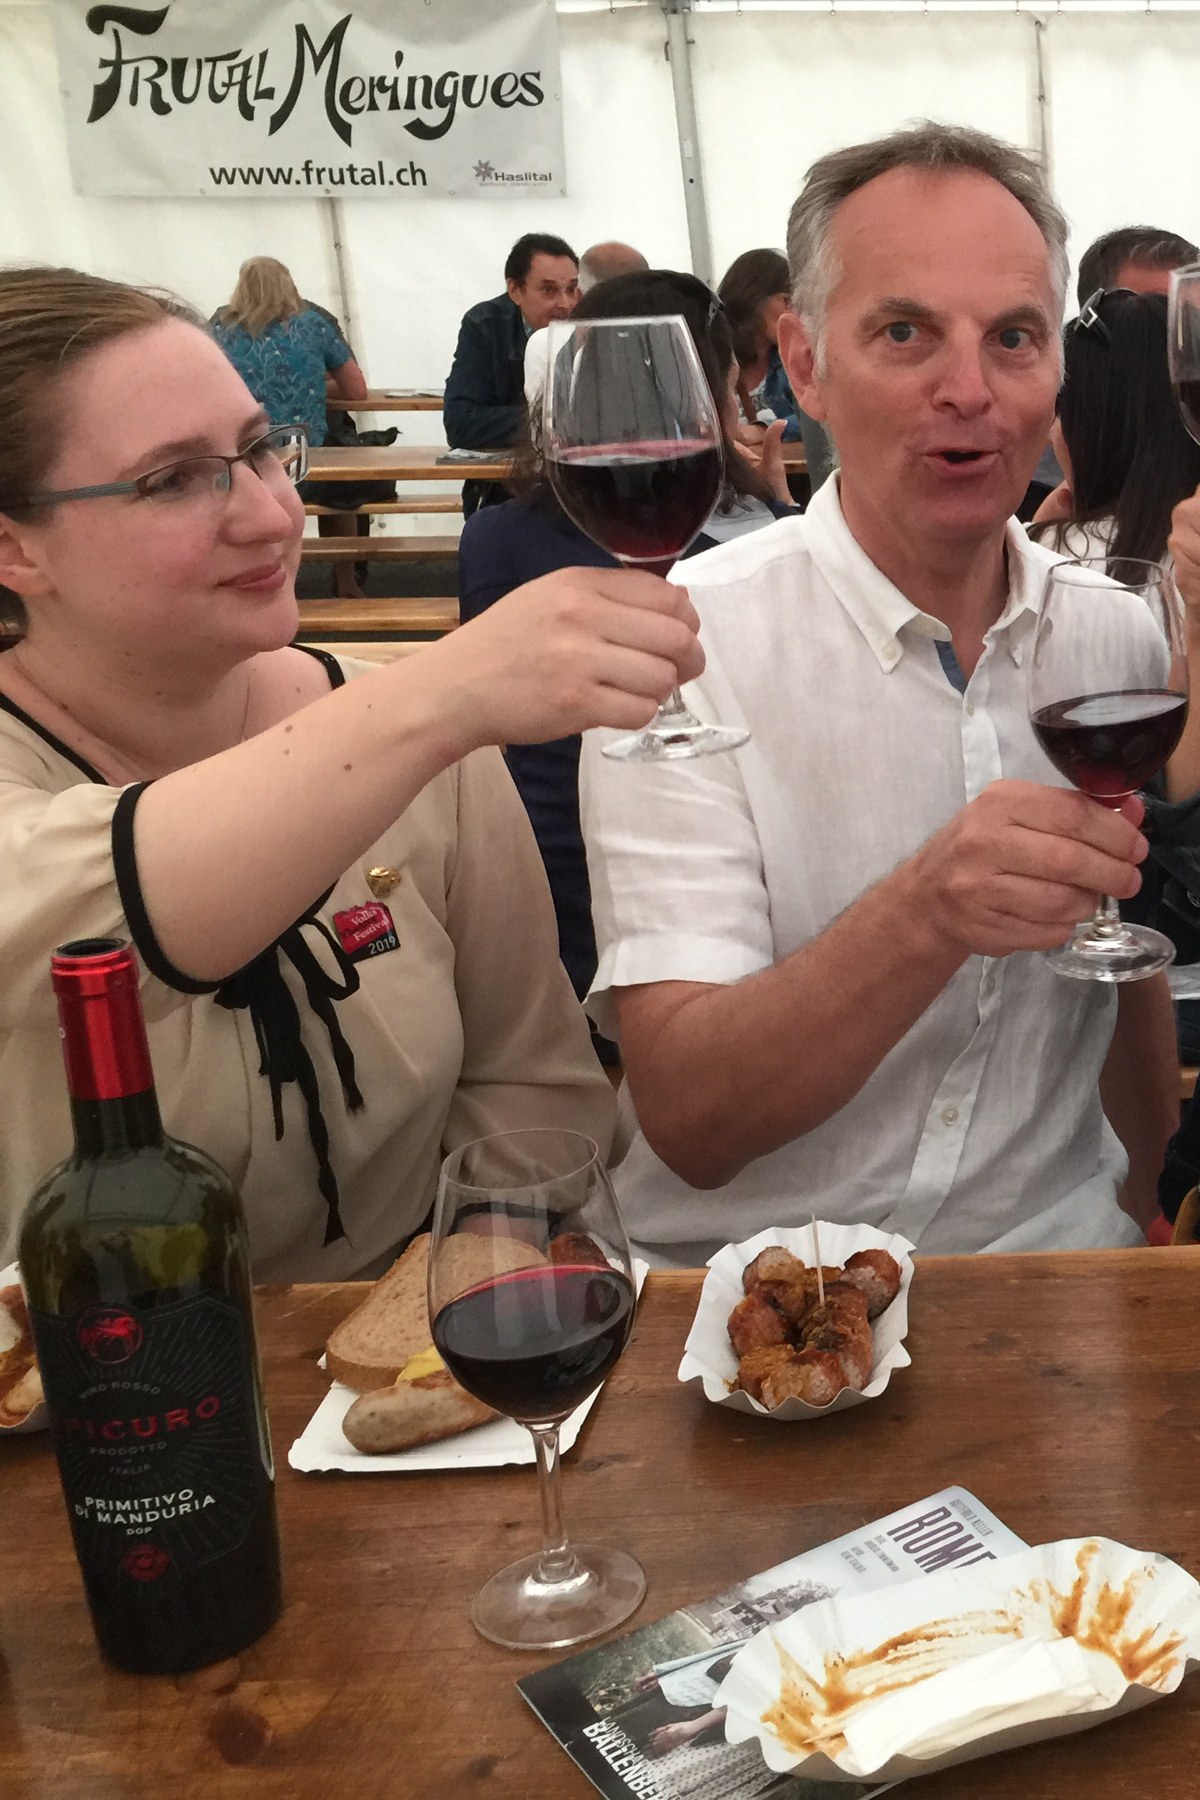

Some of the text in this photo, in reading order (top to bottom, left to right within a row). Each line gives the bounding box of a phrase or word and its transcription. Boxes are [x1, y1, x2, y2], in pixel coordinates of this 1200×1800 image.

[268, 13, 545, 148] Meringues
[209, 160, 427, 187] www.frutal.ch
[494, 171, 553, 182] Haslital
[353, 917, 390, 942] Festival
[368, 935, 396, 955] 2019
[111, 1381, 161, 1396] ROSSO
[89, 1441, 167, 1456] PRODOTTO
[75, 1494, 217, 1524] DI MANDURIA
[84, 1488, 194, 1511] PRIMITIVO
[125, 1526, 153, 1536] DOP
